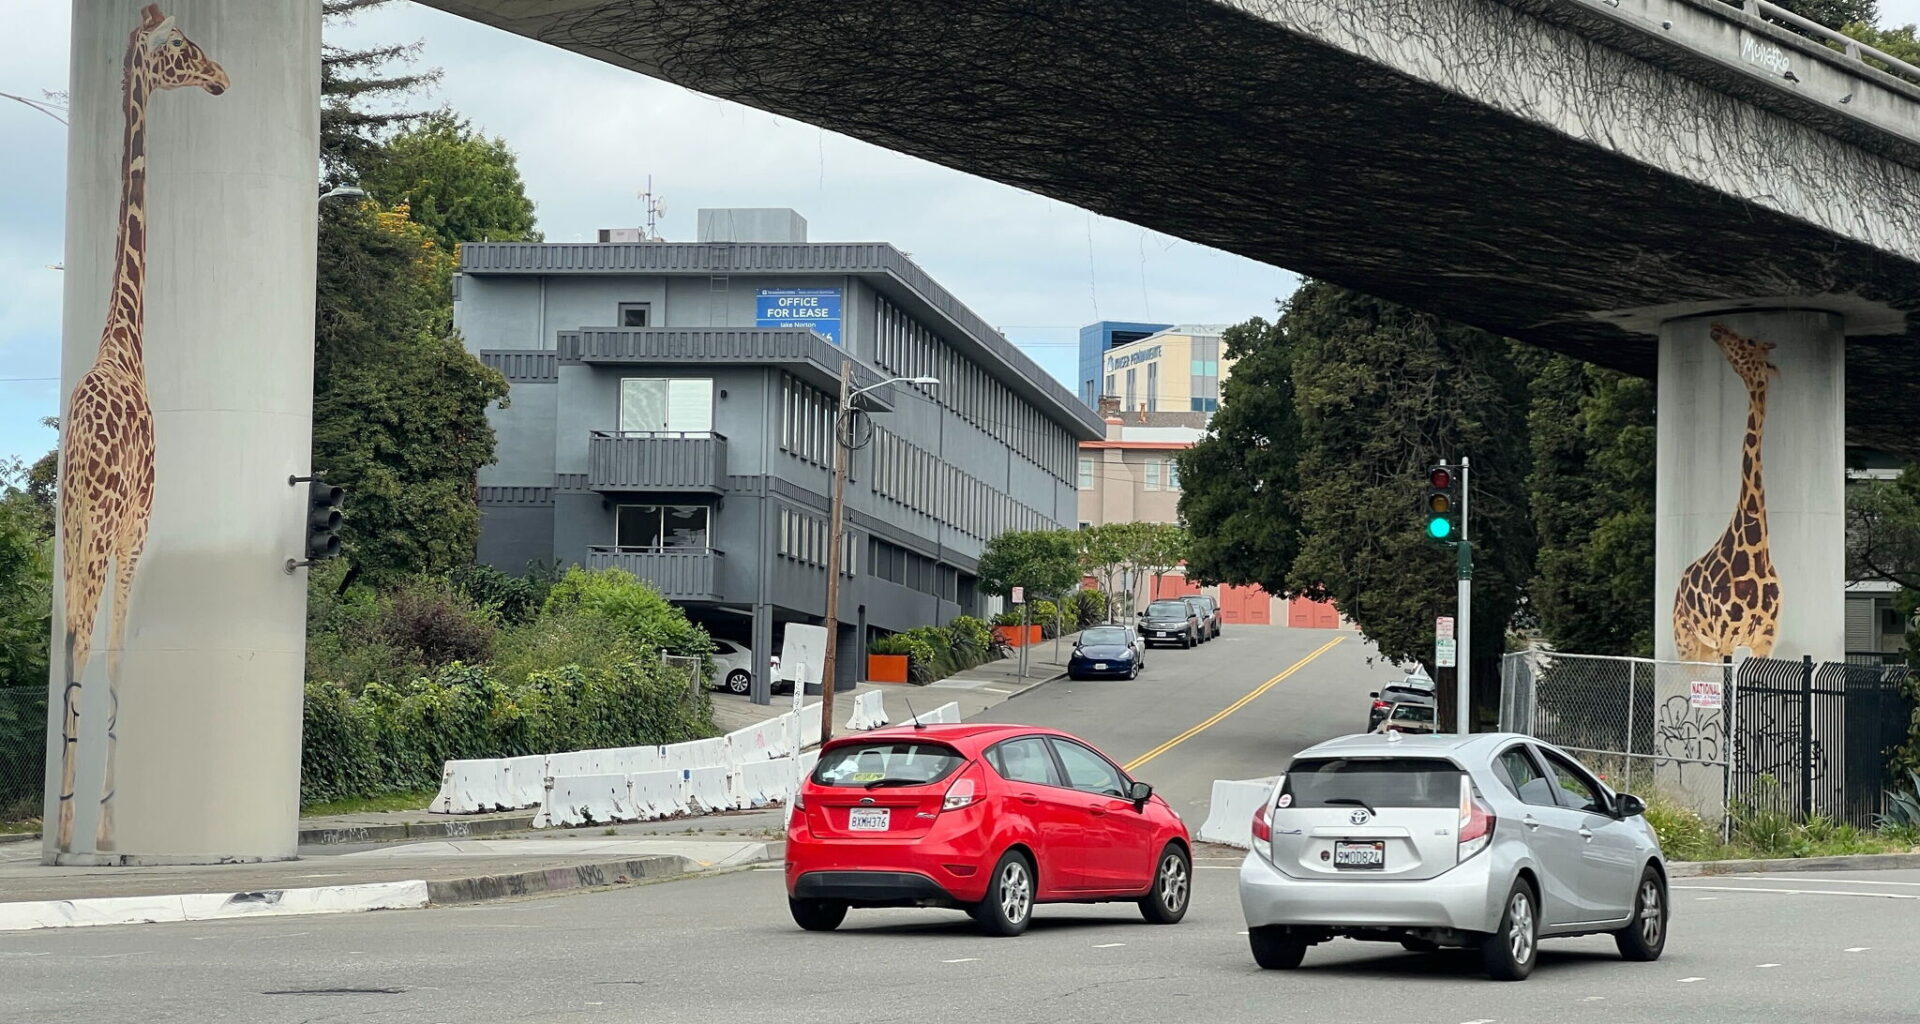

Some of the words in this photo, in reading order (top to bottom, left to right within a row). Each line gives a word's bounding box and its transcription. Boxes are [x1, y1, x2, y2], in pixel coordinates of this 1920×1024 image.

[778, 297, 818, 307] OFFICE
[767, 308, 790, 317] FOR
[792, 308, 829, 317] LEASE
[1691, 683, 1721, 695] NATIONAL
[851, 816, 887, 828] 8XMH376
